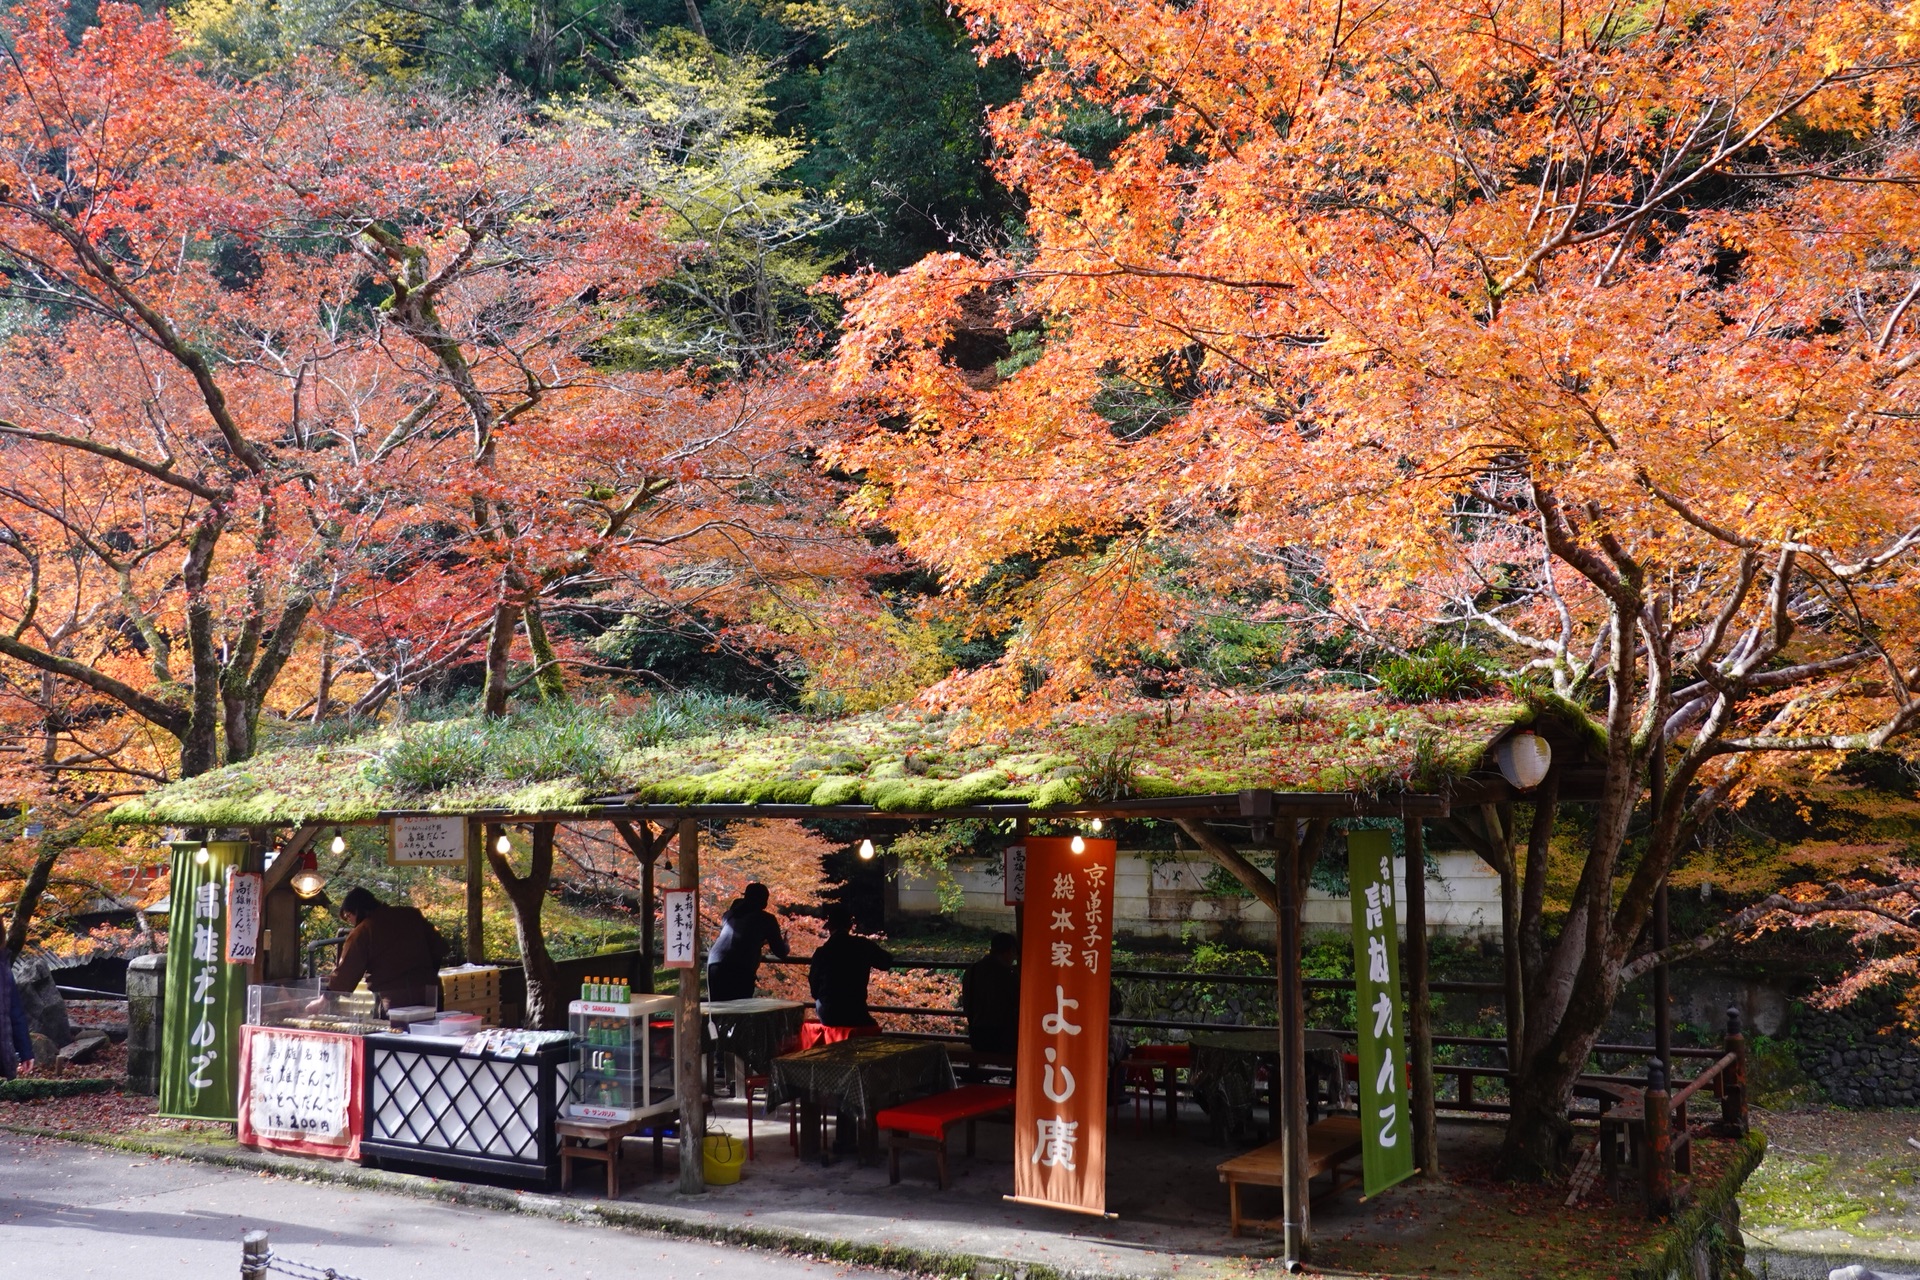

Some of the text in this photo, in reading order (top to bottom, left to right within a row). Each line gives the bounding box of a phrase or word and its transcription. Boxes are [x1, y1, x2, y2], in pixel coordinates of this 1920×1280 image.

[188, 882, 221, 1088] 高雄だんご
[672, 903, 685, 958] 出来ます
[1083, 862, 1108, 975] 京菓子司
[1031, 872, 1082, 1173] 総本家 よし廣
